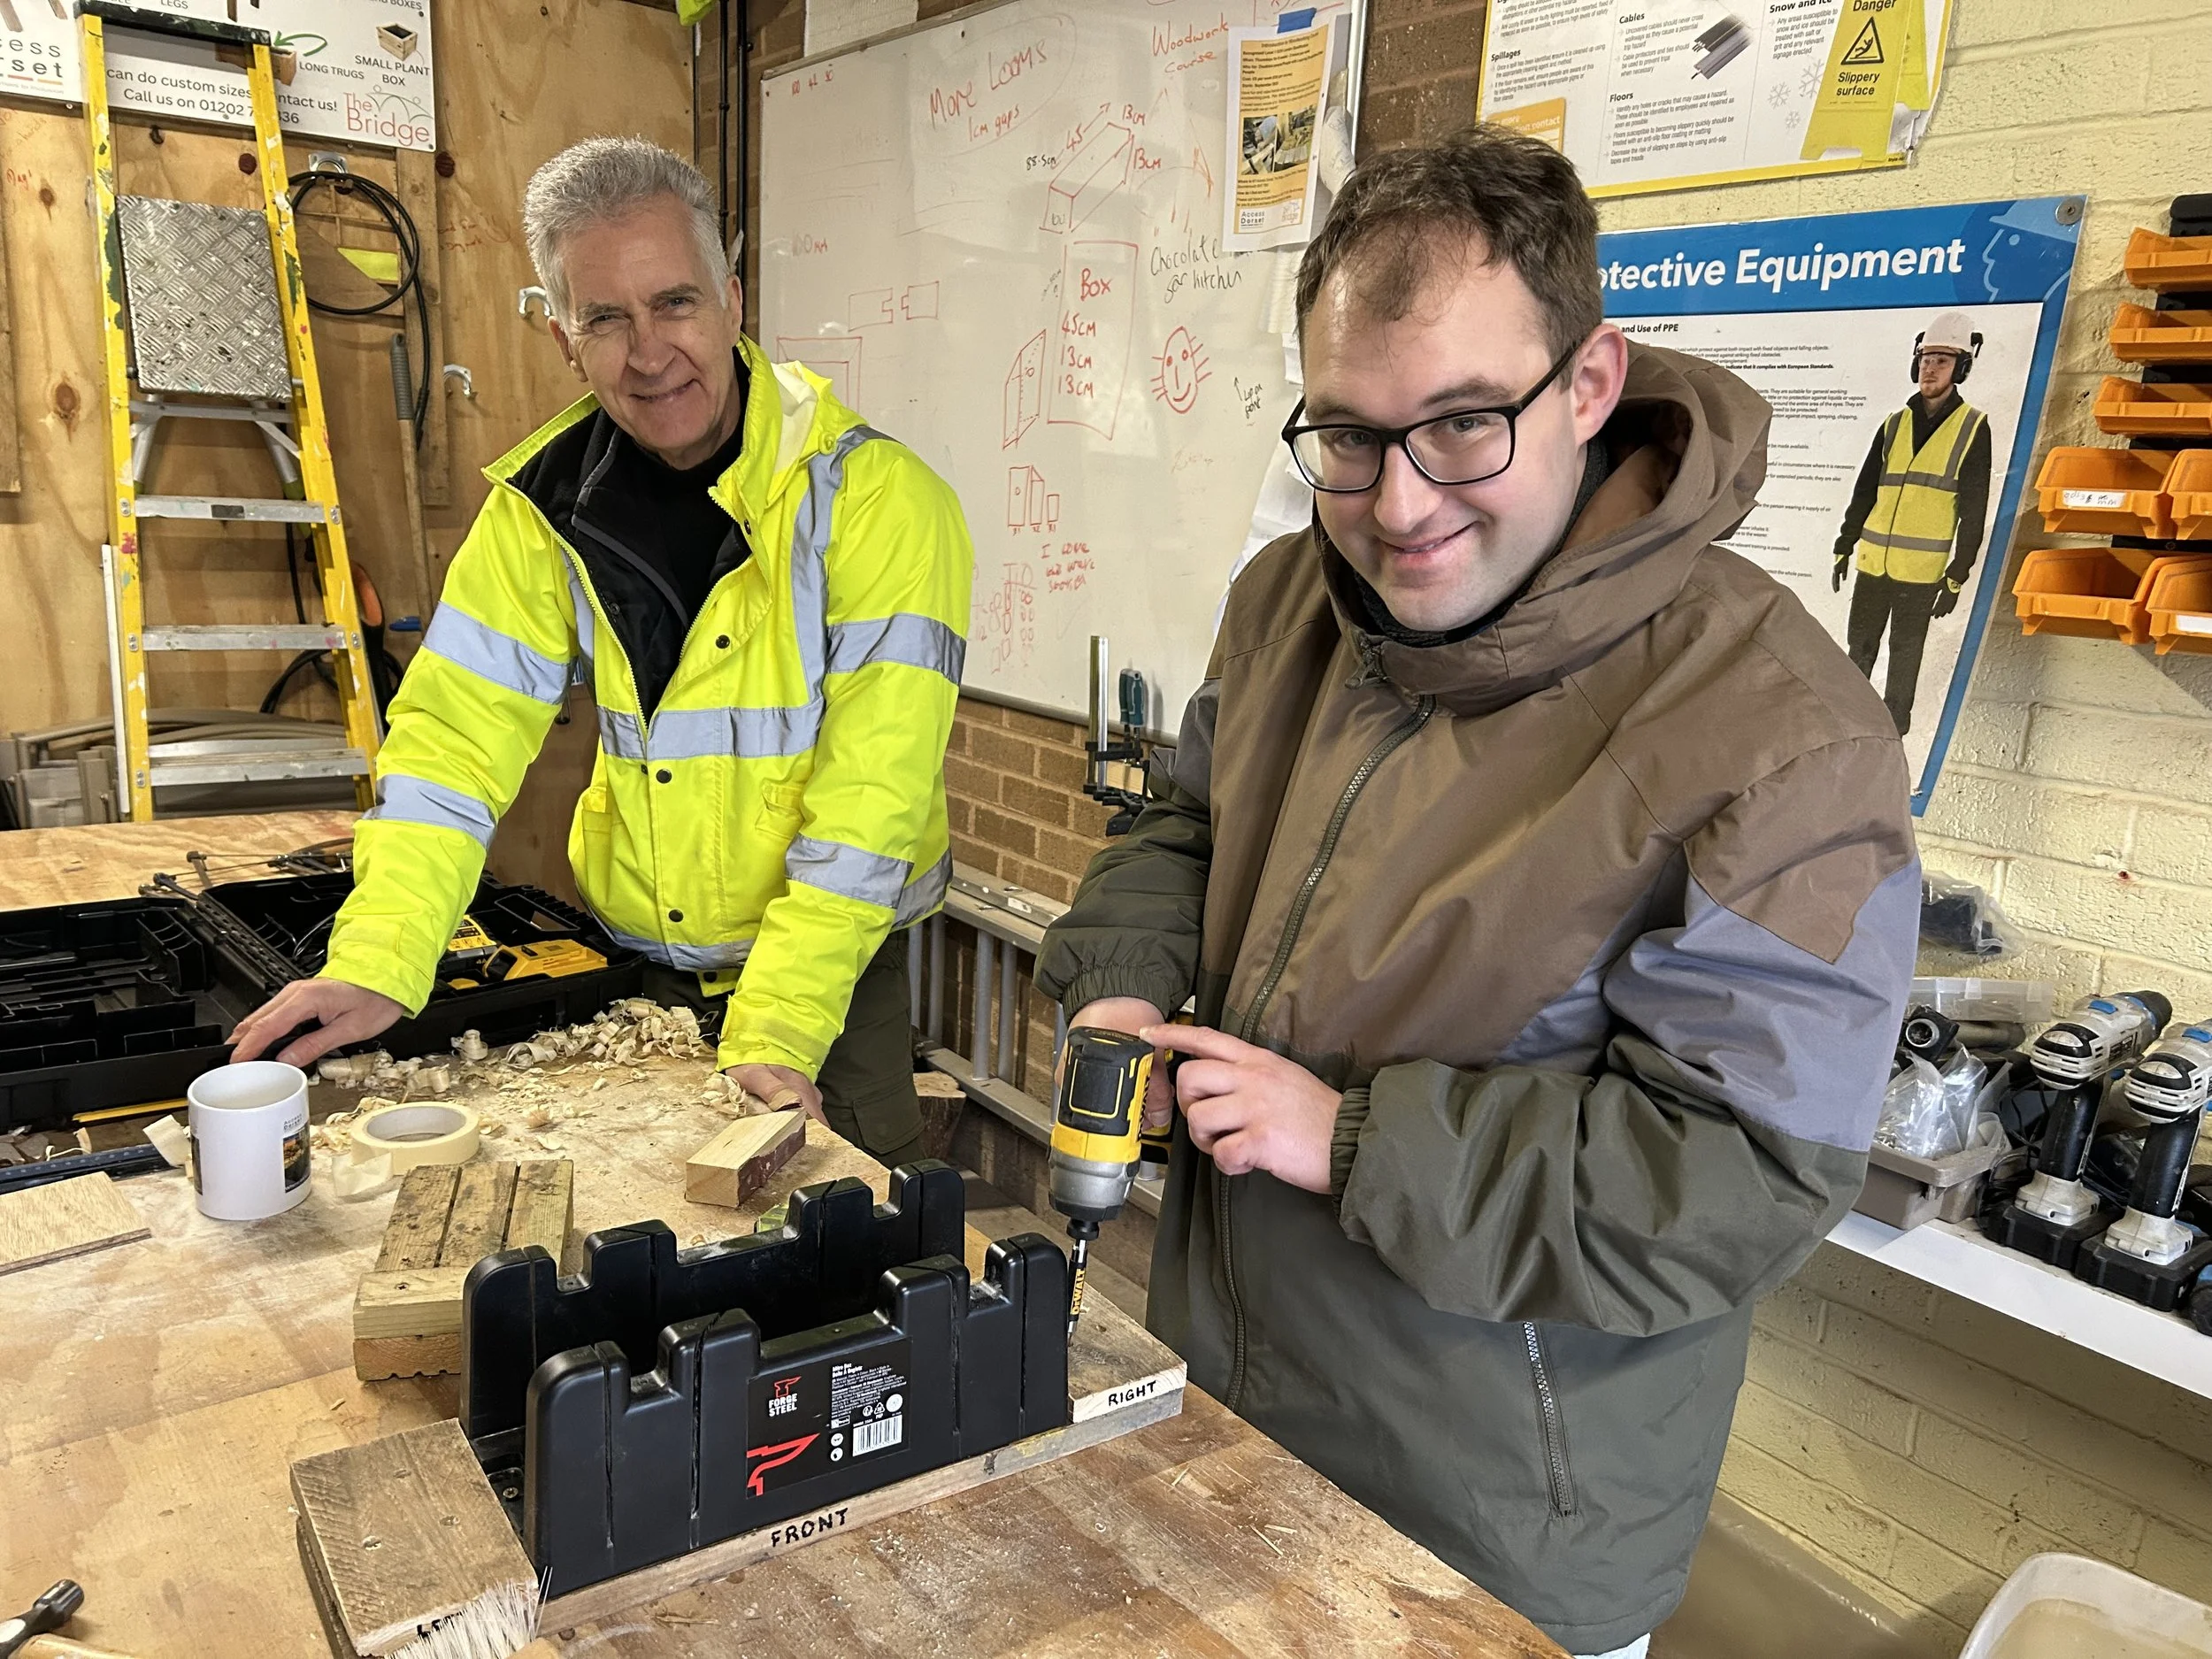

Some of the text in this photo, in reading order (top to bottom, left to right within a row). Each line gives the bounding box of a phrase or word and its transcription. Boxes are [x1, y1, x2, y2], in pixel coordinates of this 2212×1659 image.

[1770, 2, 1795, 13] Snow
[1853, 0, 1896, 12] Danger
[1619, 12, 1645, 24] Cables
[1777, 17, 1786, 26] Any
[1803, 9, 1831, 20] susceptible
[1153, 12, 1229, 57] Woodwork
[1803, 36, 1824, 46] relevant
[0, 38, 61, 58] ess
[1491, 49, 1521, 63] Spillages
[1773, 47, 1812, 59] signage erected
[299, 61, 365, 80] LONG TRUGS
[355, 55, 430, 76] SMALL PLANT
[382, 74, 405, 86] BOX
[1838, 72, 1880, 84] Slippery
[107, 68, 133, 81] can
[138, 72, 157, 85] do
[161, 76, 215, 93] custom
[318, 99, 337, 111] us!
[1609, 92, 1633, 103] Floors
[1836, 86, 1875, 96] surface
[124, 88, 152, 104] Call
[157, 95, 173, 105] us
[177, 99, 195, 110] on
[200, 99, 244, 116] 01202
[344, 92, 372, 111] The
[930, 80, 977, 131] More
[347, 106, 430, 147] Bridge
[1735, 238, 1966, 293] Equipment
[1621, 323, 1678, 334] and Use of PPE
[768, 1393, 798, 1409] FORGE
[1108, 1380, 1156, 1406] RIGHT
[768, 1402, 798, 1417] STEEL
[771, 1507, 849, 1548] FRONT
